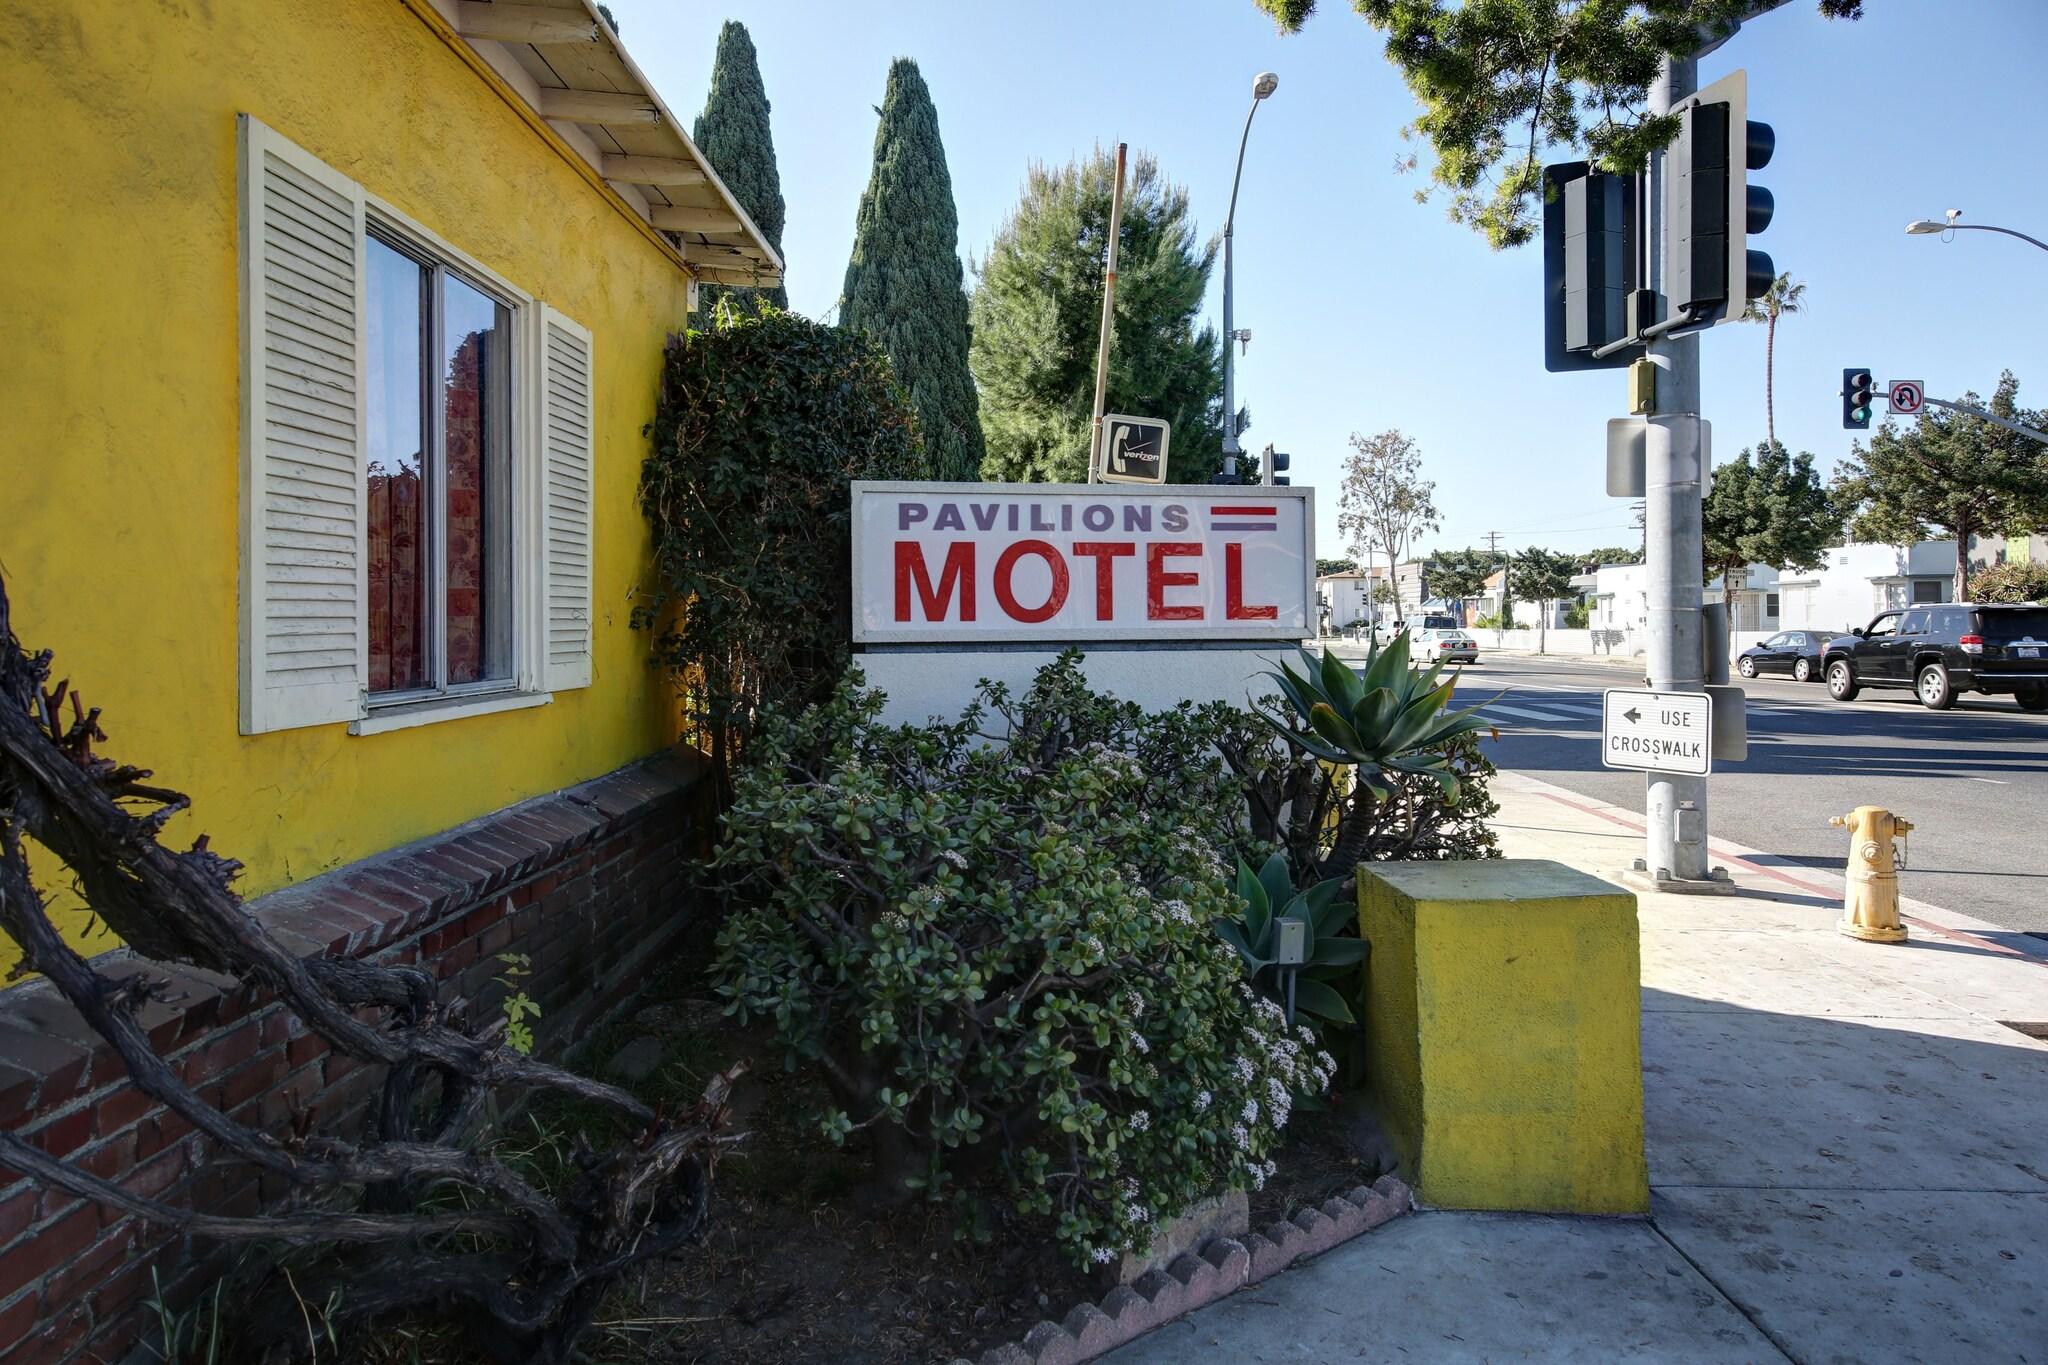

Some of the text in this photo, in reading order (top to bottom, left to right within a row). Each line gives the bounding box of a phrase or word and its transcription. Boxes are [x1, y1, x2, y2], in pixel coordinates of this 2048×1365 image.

[1124, 450, 1159, 462] verizon
[898, 502, 1189, 532] PAVILIONS
[894, 539, 1278, 623] MOTEL
[1661, 710, 1691, 727] USE
[1611, 735, 1701, 758] CROSSWALK
